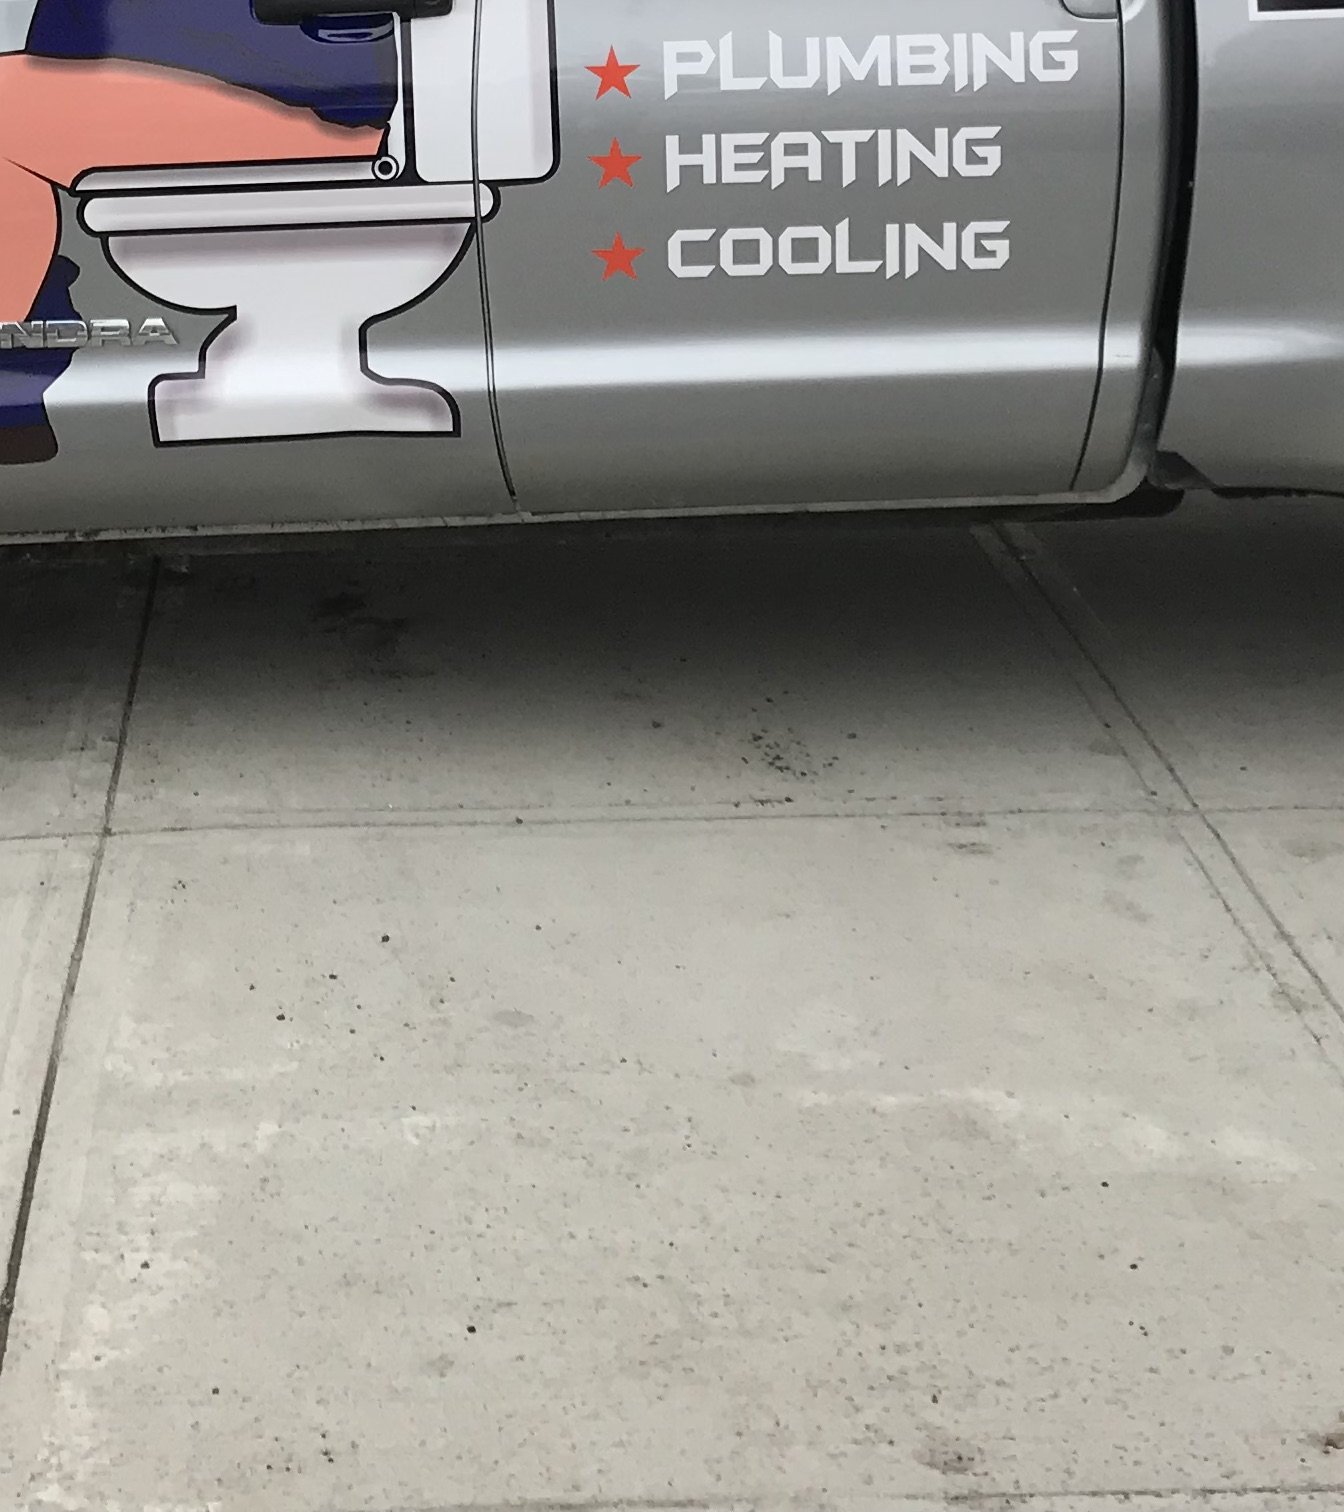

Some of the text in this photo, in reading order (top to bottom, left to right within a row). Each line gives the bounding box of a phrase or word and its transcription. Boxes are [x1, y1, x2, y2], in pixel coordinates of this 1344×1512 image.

[662, 29, 1079, 100] PLUMBING
[665, 125, 1003, 193] HEATING
[667, 217, 1011, 280] COOLING
